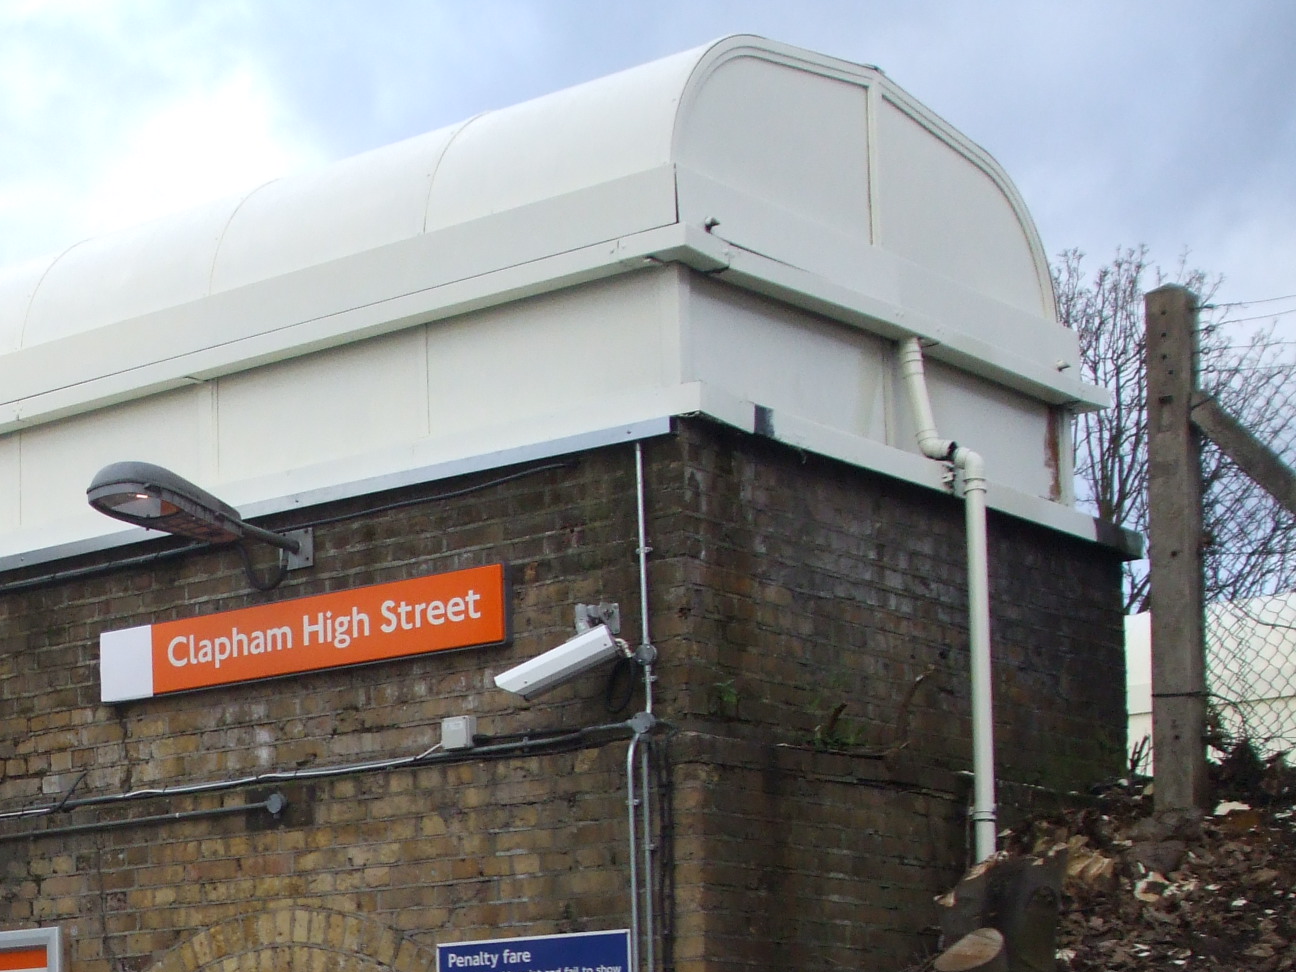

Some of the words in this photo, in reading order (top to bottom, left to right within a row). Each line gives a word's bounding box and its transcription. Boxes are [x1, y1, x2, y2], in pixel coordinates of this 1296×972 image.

[167, 624, 292, 669] Clapham
[303, 606, 370, 649] High
[380, 590, 481, 633] Street
[448, 952, 498, 968] Penalty
[504, 949, 531, 964] fare
